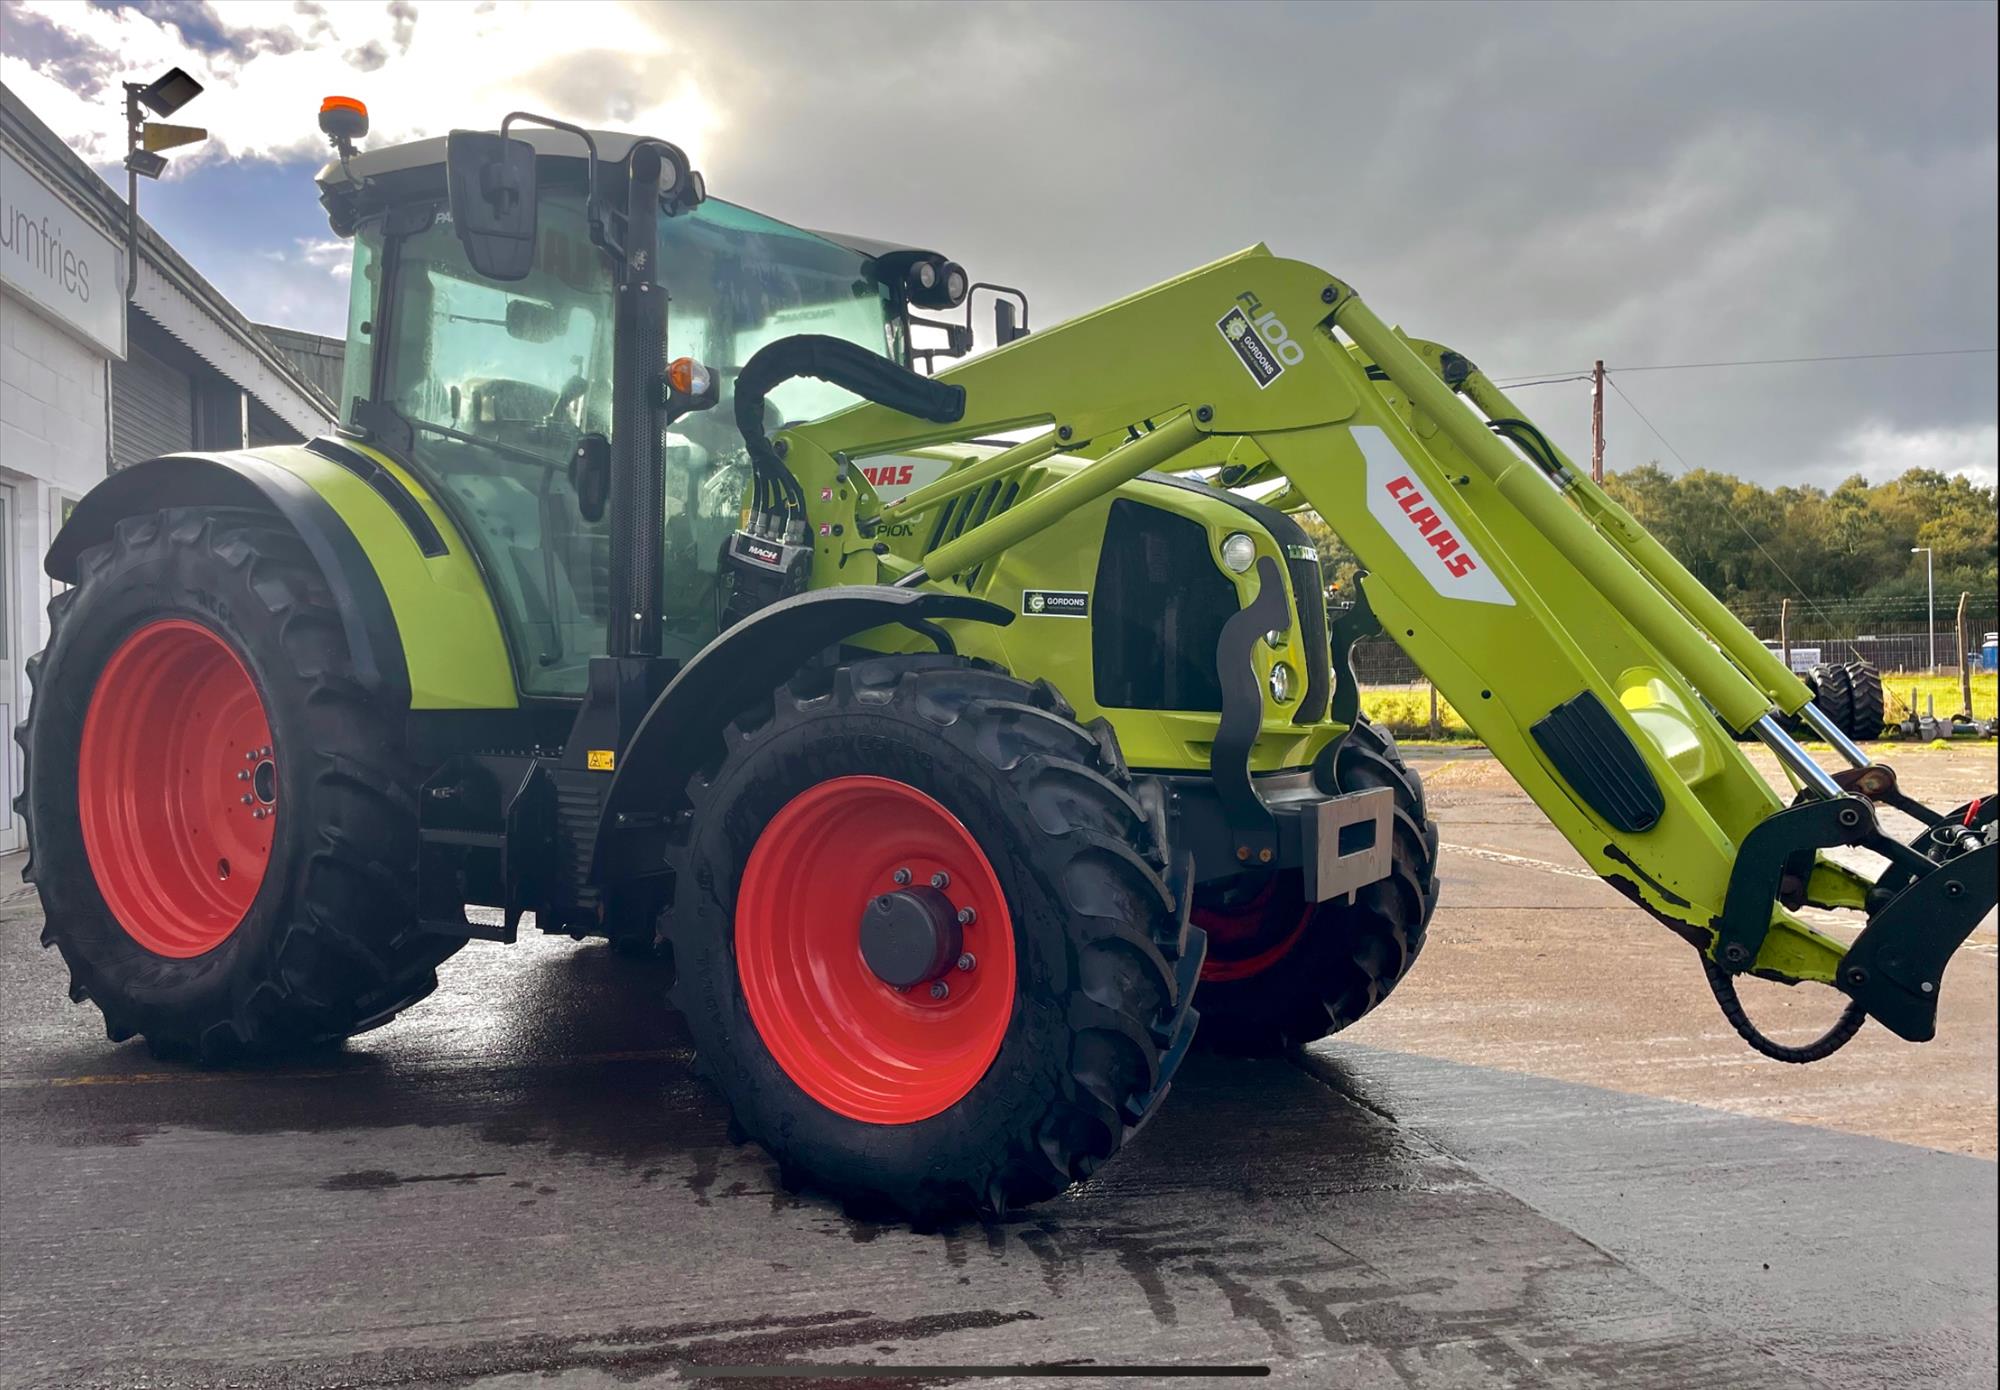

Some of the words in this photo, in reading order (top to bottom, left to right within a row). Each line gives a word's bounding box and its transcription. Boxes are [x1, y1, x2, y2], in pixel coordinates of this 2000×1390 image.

[0, 204, 89, 304] umfries
[1243, 336, 1274, 375] GORDONS
[1385, 475, 1477, 578] CLAAS
[748, 545, 778, 560] MACH
[1046, 597, 1085, 606] GORDONS
